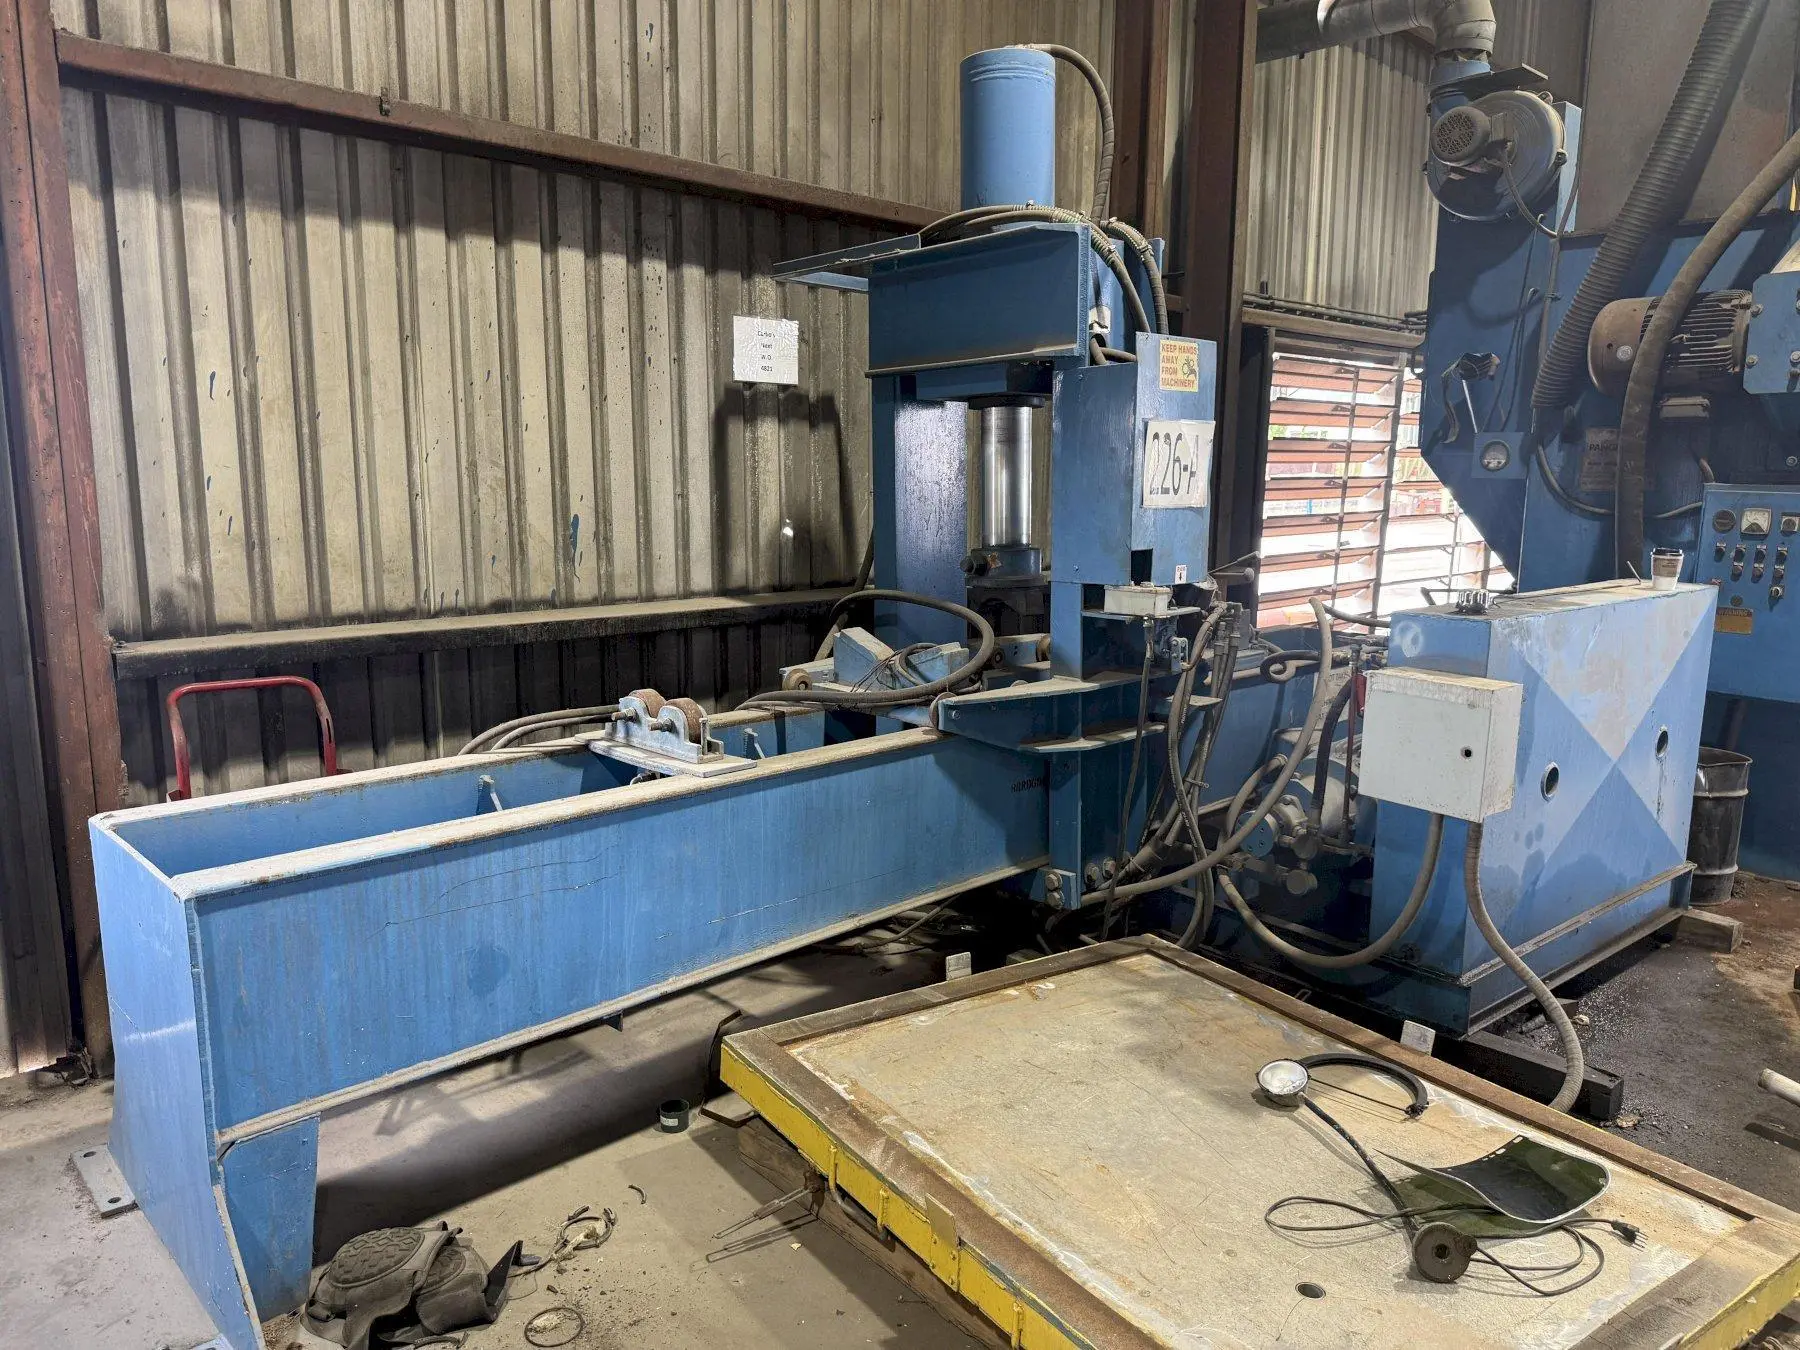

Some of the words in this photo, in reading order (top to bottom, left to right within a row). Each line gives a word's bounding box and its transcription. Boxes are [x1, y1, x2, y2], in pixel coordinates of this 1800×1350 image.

[1161, 343, 1177, 353] KEEP
[1178, 345, 1197, 355] HANDS
[1161, 355, 1178, 364] AWAY
[1161, 366, 1178, 376] FROM
[1161, 377, 1195, 388] MACHINERY
